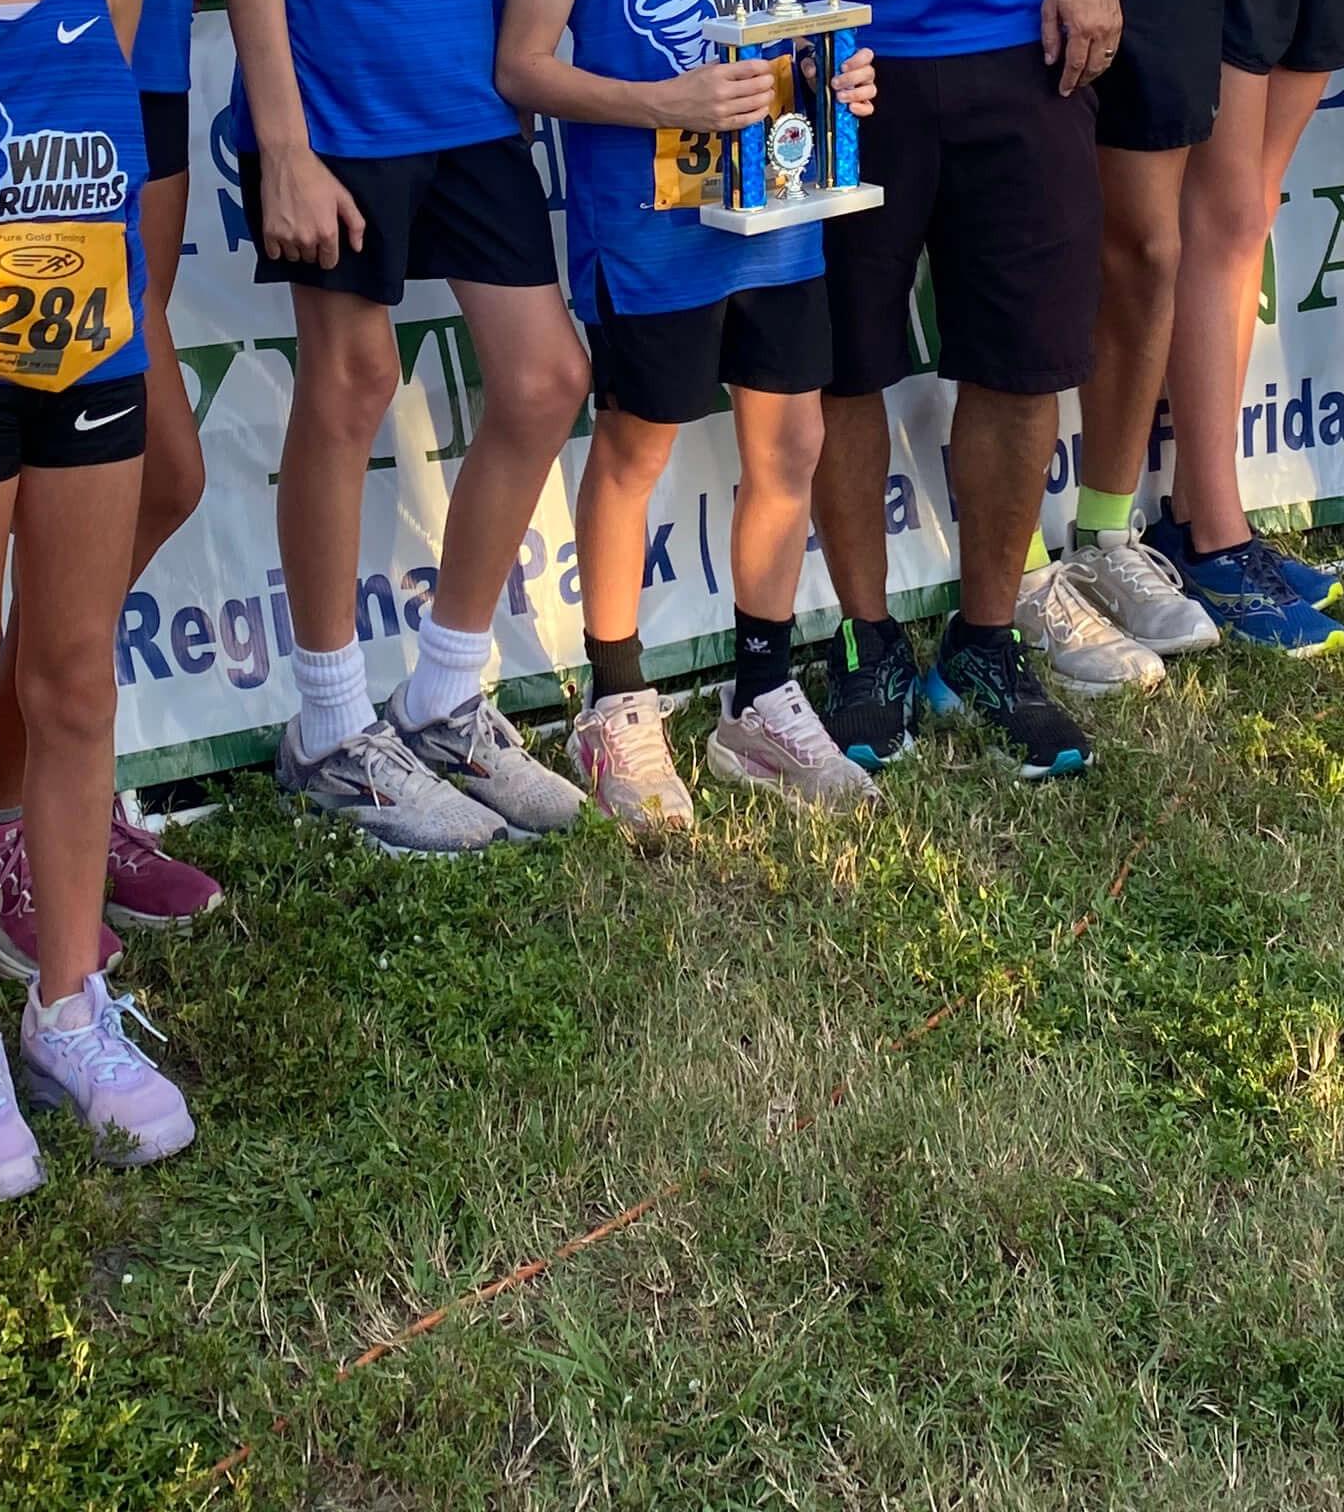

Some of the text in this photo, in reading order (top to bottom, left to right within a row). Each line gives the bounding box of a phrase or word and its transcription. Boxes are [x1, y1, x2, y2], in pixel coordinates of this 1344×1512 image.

[7, 135, 115, 184] WIND
[25, 231, 52, 242] Gold
[116, 562, 440, 690] Regina
[506, 519, 677, 617] Pak
